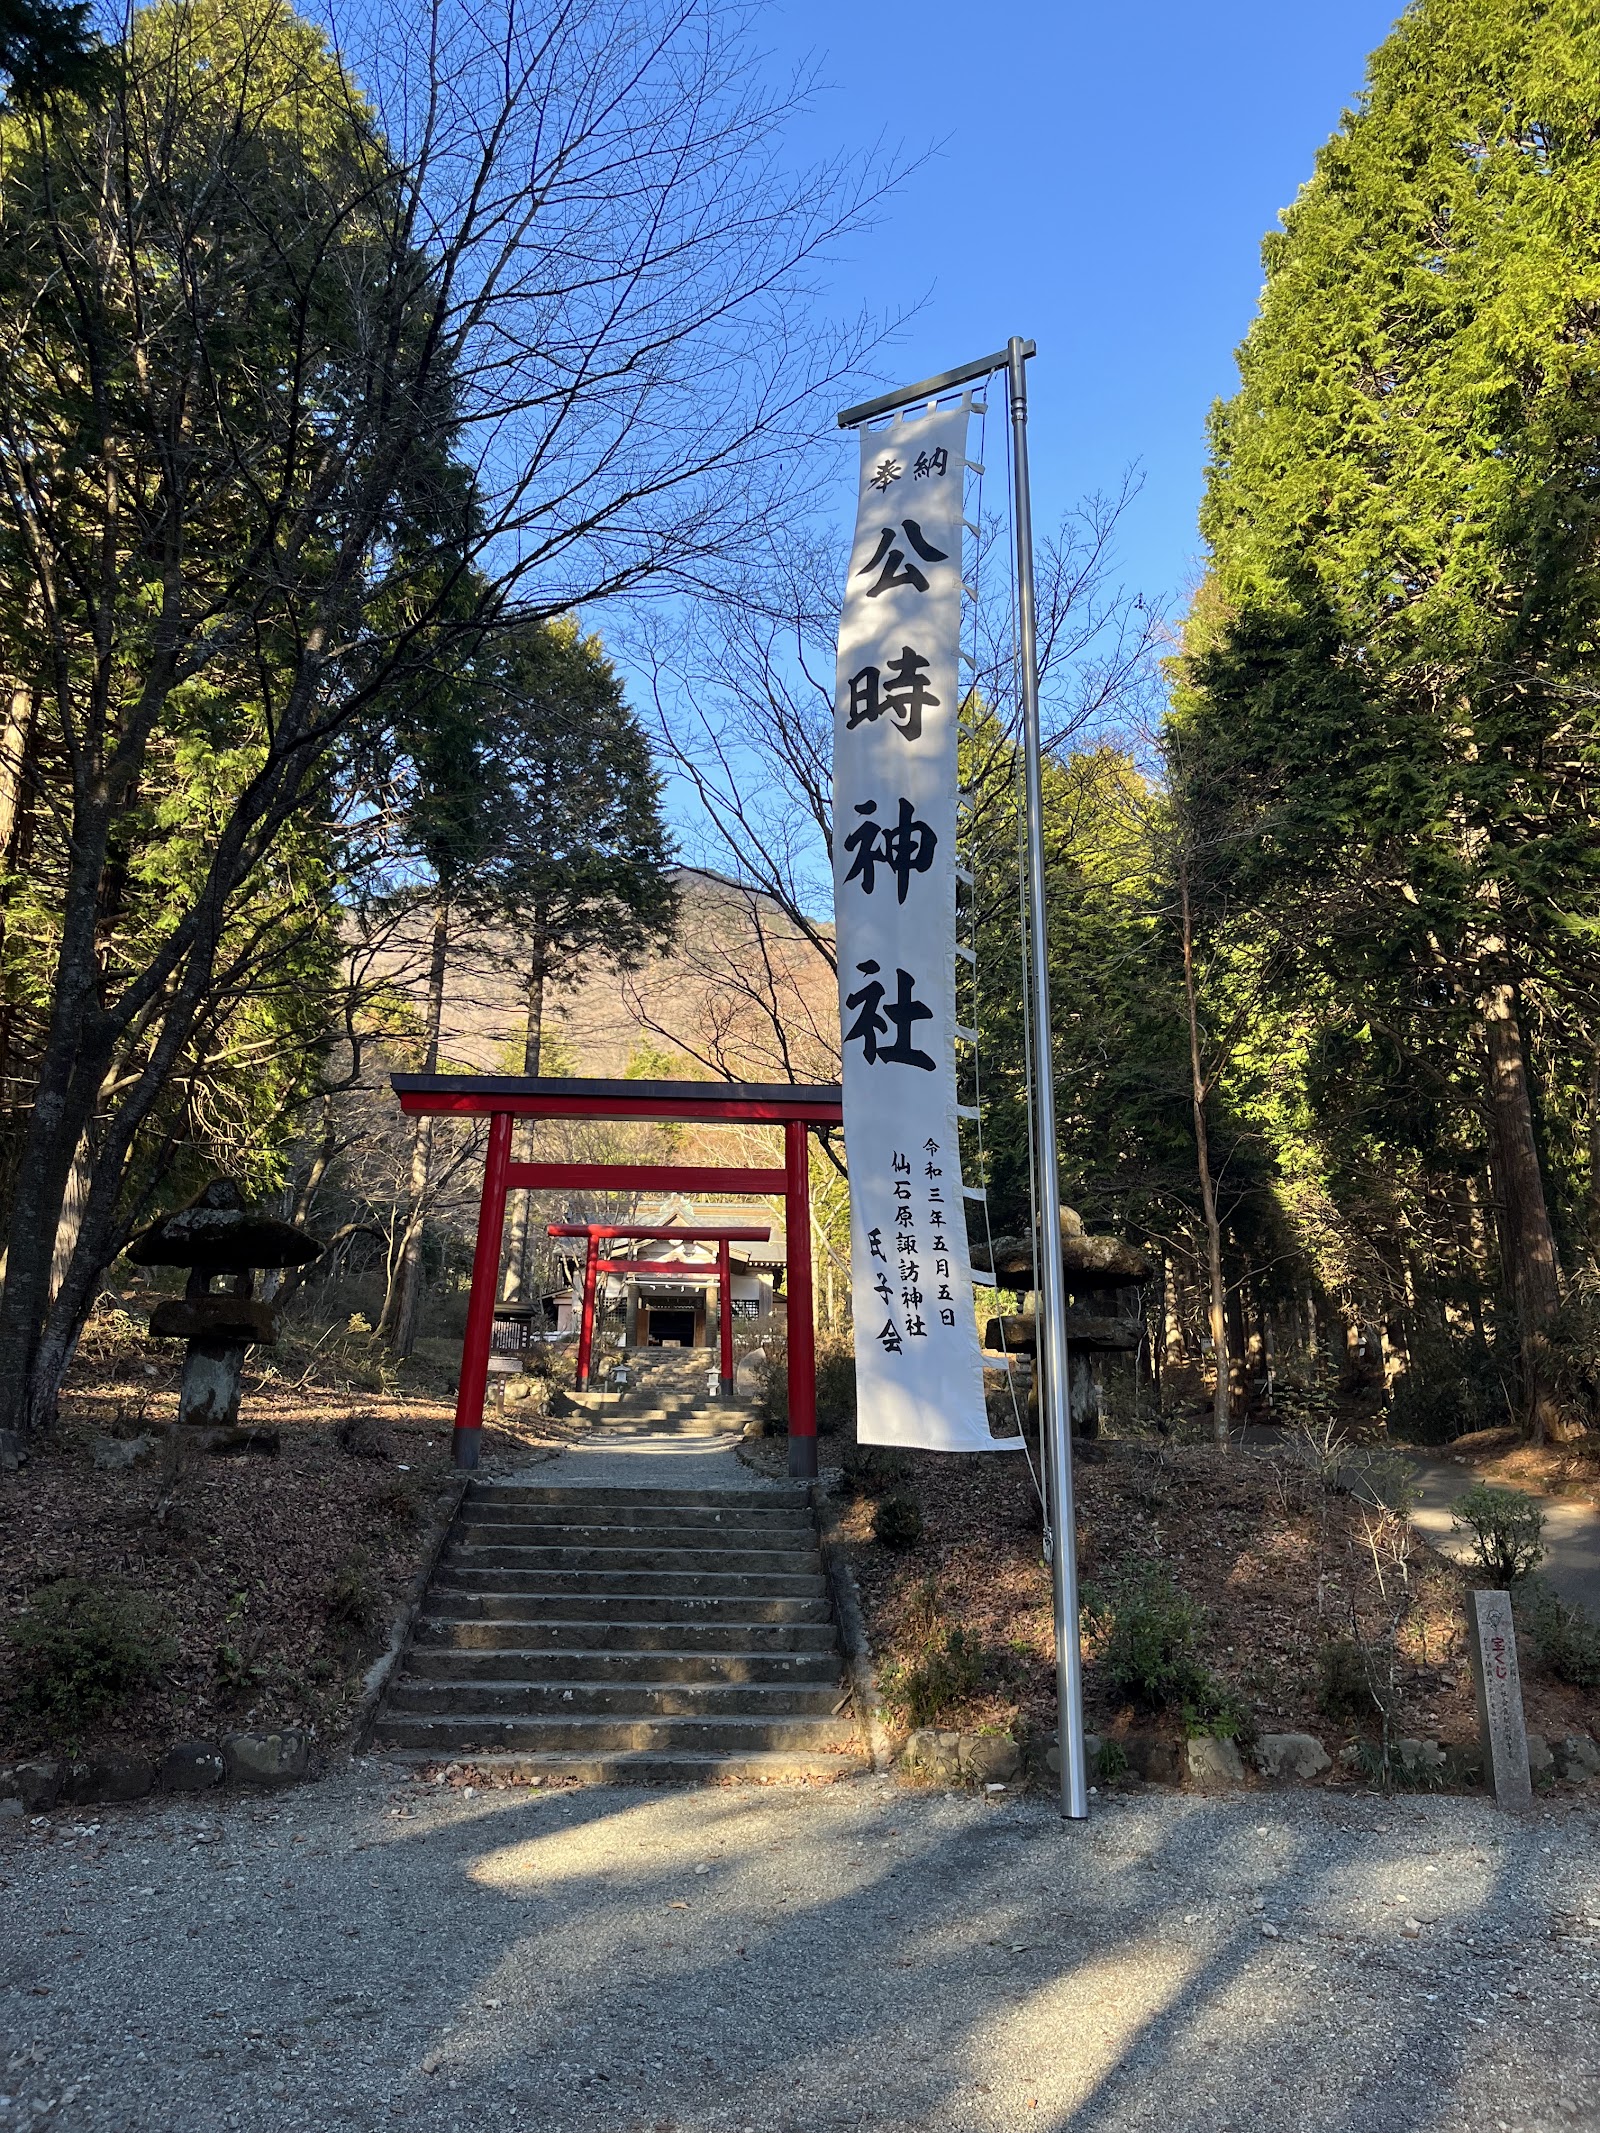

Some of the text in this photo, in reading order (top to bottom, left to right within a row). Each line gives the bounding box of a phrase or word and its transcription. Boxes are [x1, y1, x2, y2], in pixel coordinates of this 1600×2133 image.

[867, 447, 949, 494] 奉納
[843, 519, 949, 1072] 公時神社
[867, 1227, 904, 1356] 氏子会
[891, 1150, 927, 1338] 仙石原諏訪神社
[922, 1137, 955, 1328] 令和三年五月五日
